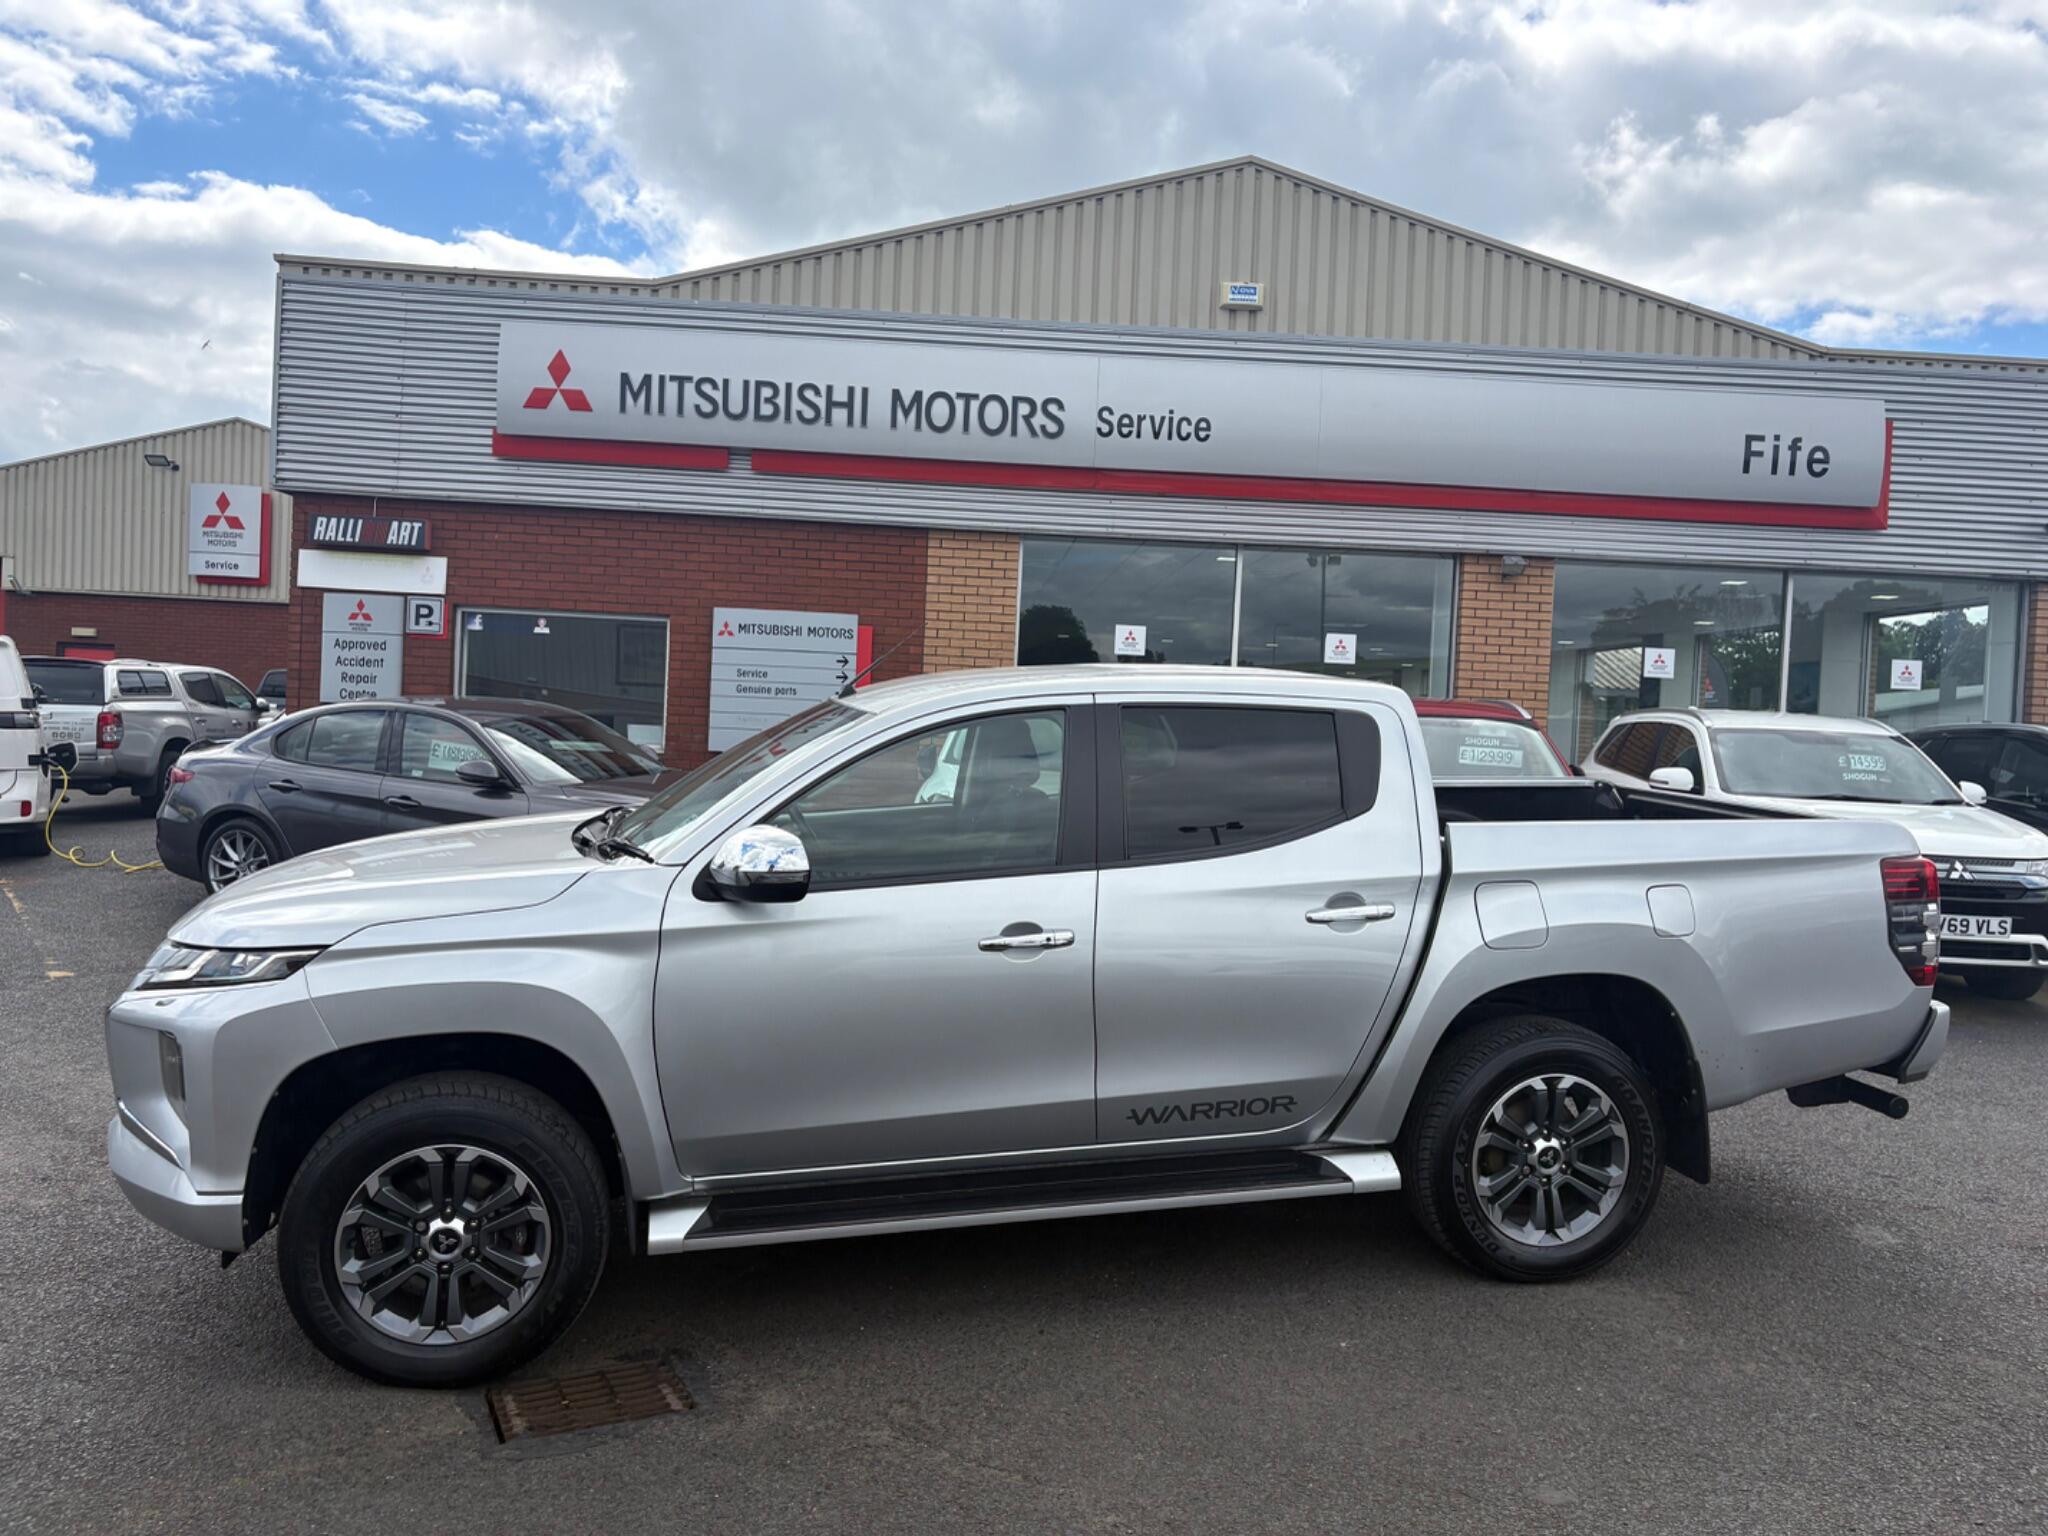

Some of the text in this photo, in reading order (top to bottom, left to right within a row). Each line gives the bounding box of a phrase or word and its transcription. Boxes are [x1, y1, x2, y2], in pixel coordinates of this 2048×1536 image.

[619, 372, 1212, 442] MITSUBISHI MOTORS Service
[1742, 434, 1831, 478] Fife
[313, 516, 423, 546] RALLI ART
[208, 539, 237, 547] MOTORS
[204, 560, 239, 570] Service
[414, 603, 434, 626] P
[738, 622, 854, 640] MITSUBISHI MOTORS
[333, 638, 387, 652] Approved
[335, 655, 385, 669] Accident
[340, 671, 378, 686] Repair
[736, 668, 768, 679] Service
[736, 683, 797, 697] Genuine parts
[1464, 736, 1500, 747] SHOGUN
[1975, 919, 2009, 936] VLS
[1126, 1095, 1297, 1126] WARRIOR
